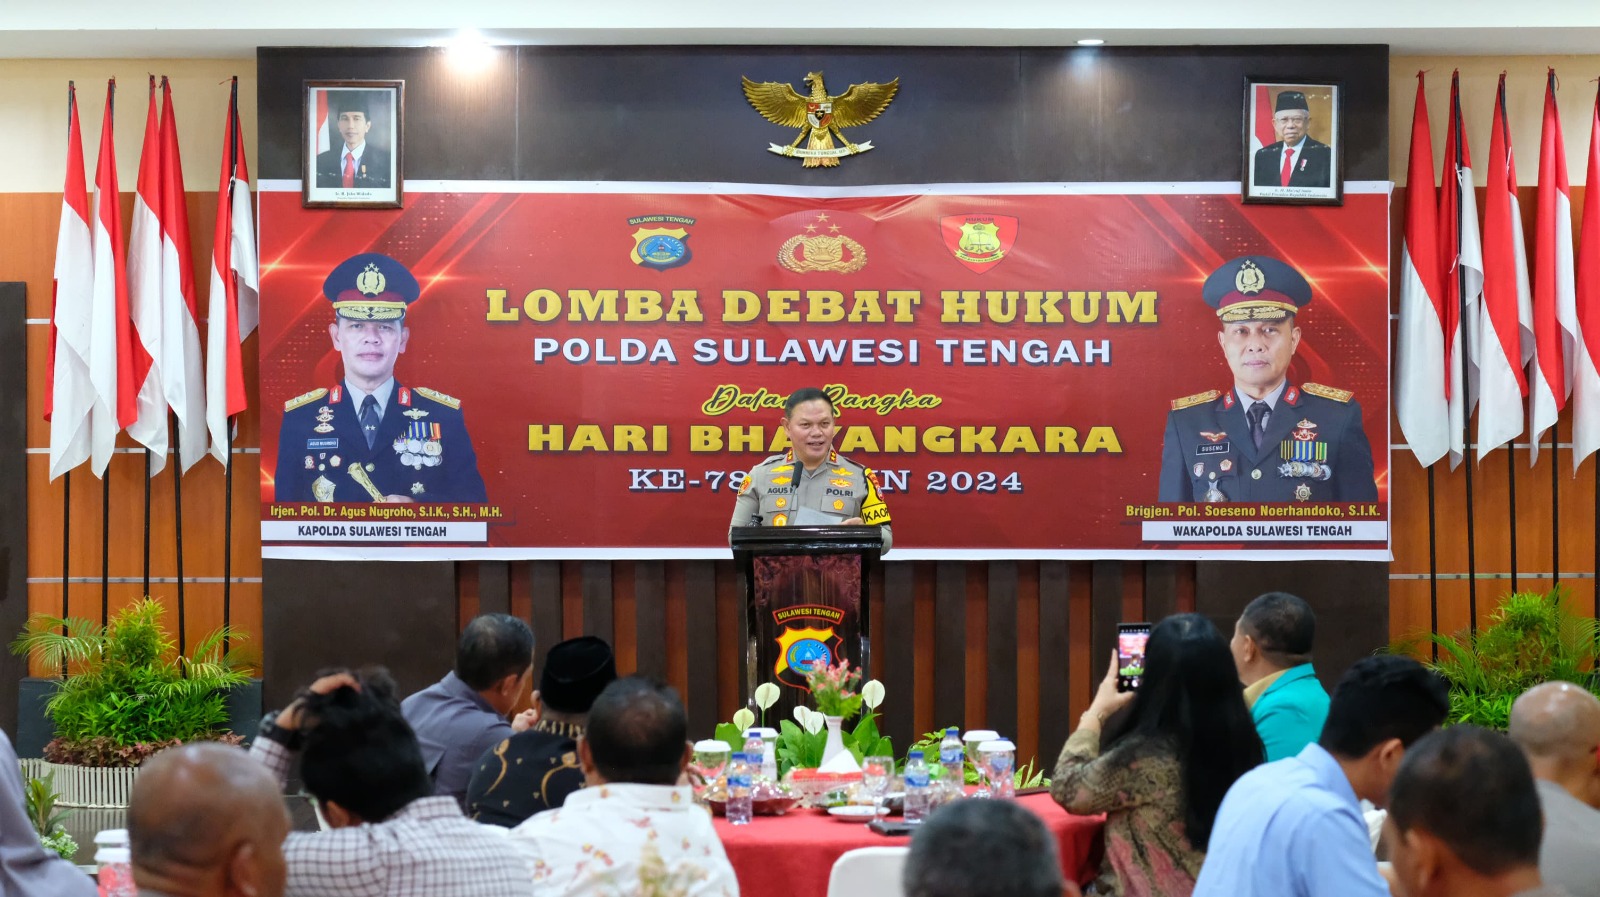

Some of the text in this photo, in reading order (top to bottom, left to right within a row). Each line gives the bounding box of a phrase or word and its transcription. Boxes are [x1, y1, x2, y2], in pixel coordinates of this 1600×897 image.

[629, 216, 695, 225] SULAWESI TENGAH
[486, 289, 1158, 324] LOMBA DEBAT HUKUM
[534, 338, 1111, 364] POLDA SULAWESI TENGAH
[701, 384, 789, 416] Dala
[528, 424, 1123, 453] HARI BHAANGKARA
[628, 468, 749, 491] KE-78
[926, 471, 1023, 492] 2024
[826, 488, 854, 497] POLRI
[270, 505, 503, 519] Irjen. Pol. Dr. Agus Nugroho, S.I.K., S.H., M.H.
[1126, 505, 1380, 518] Brigjen. Pol. Soeseno Noerhandoko, S.I.K.
[298, 526, 447, 537] KAPOLDA SULAWESI TENGAH
[1173, 525, 1352, 537] WAKAPOLDA SULAWESI TENGAH
[777, 608, 841, 620] SULAWESI TENGAH
